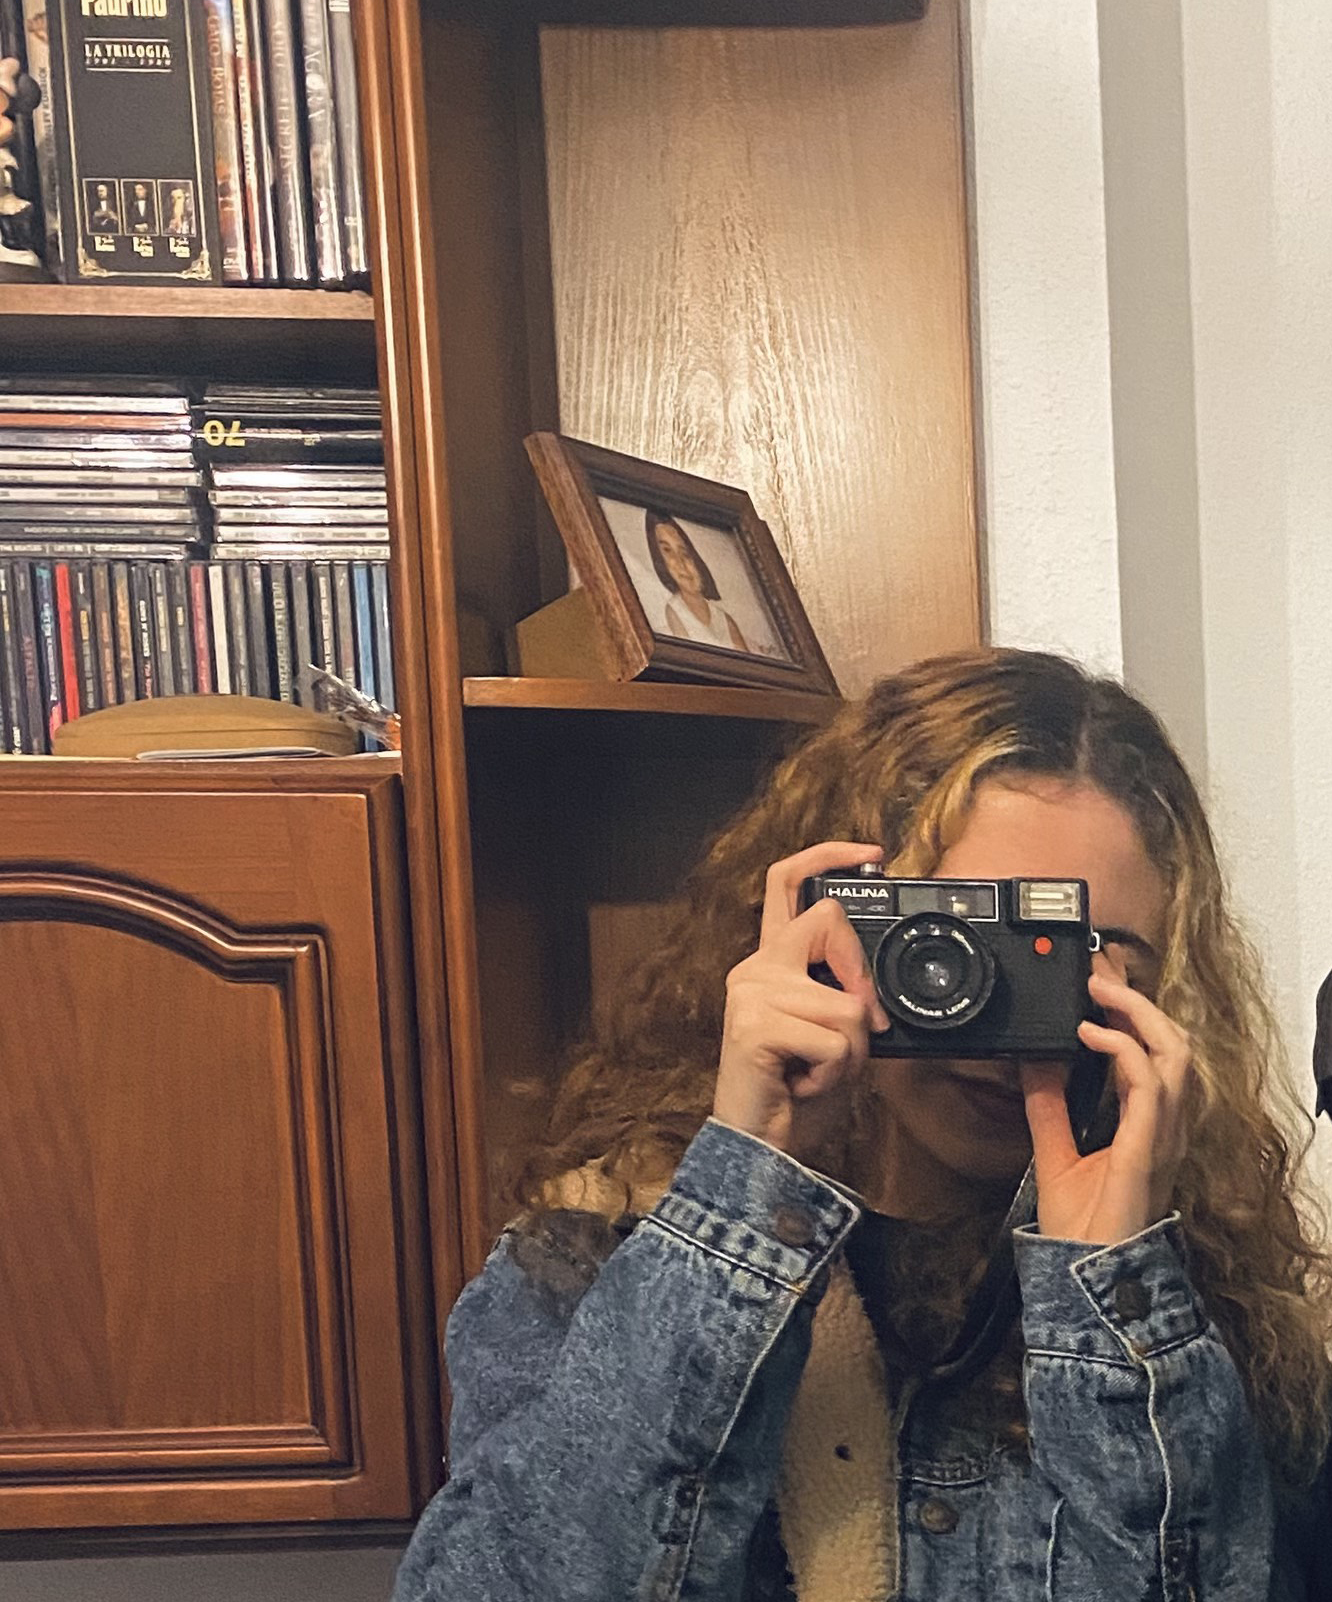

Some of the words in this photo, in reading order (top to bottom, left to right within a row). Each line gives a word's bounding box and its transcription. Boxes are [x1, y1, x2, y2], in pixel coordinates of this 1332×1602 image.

[84, 44, 102, 57] LA
[105, 44, 171, 58] TRILOGIA
[203, 419, 246, 447] 70
[828, 887, 889, 898] HALINA
